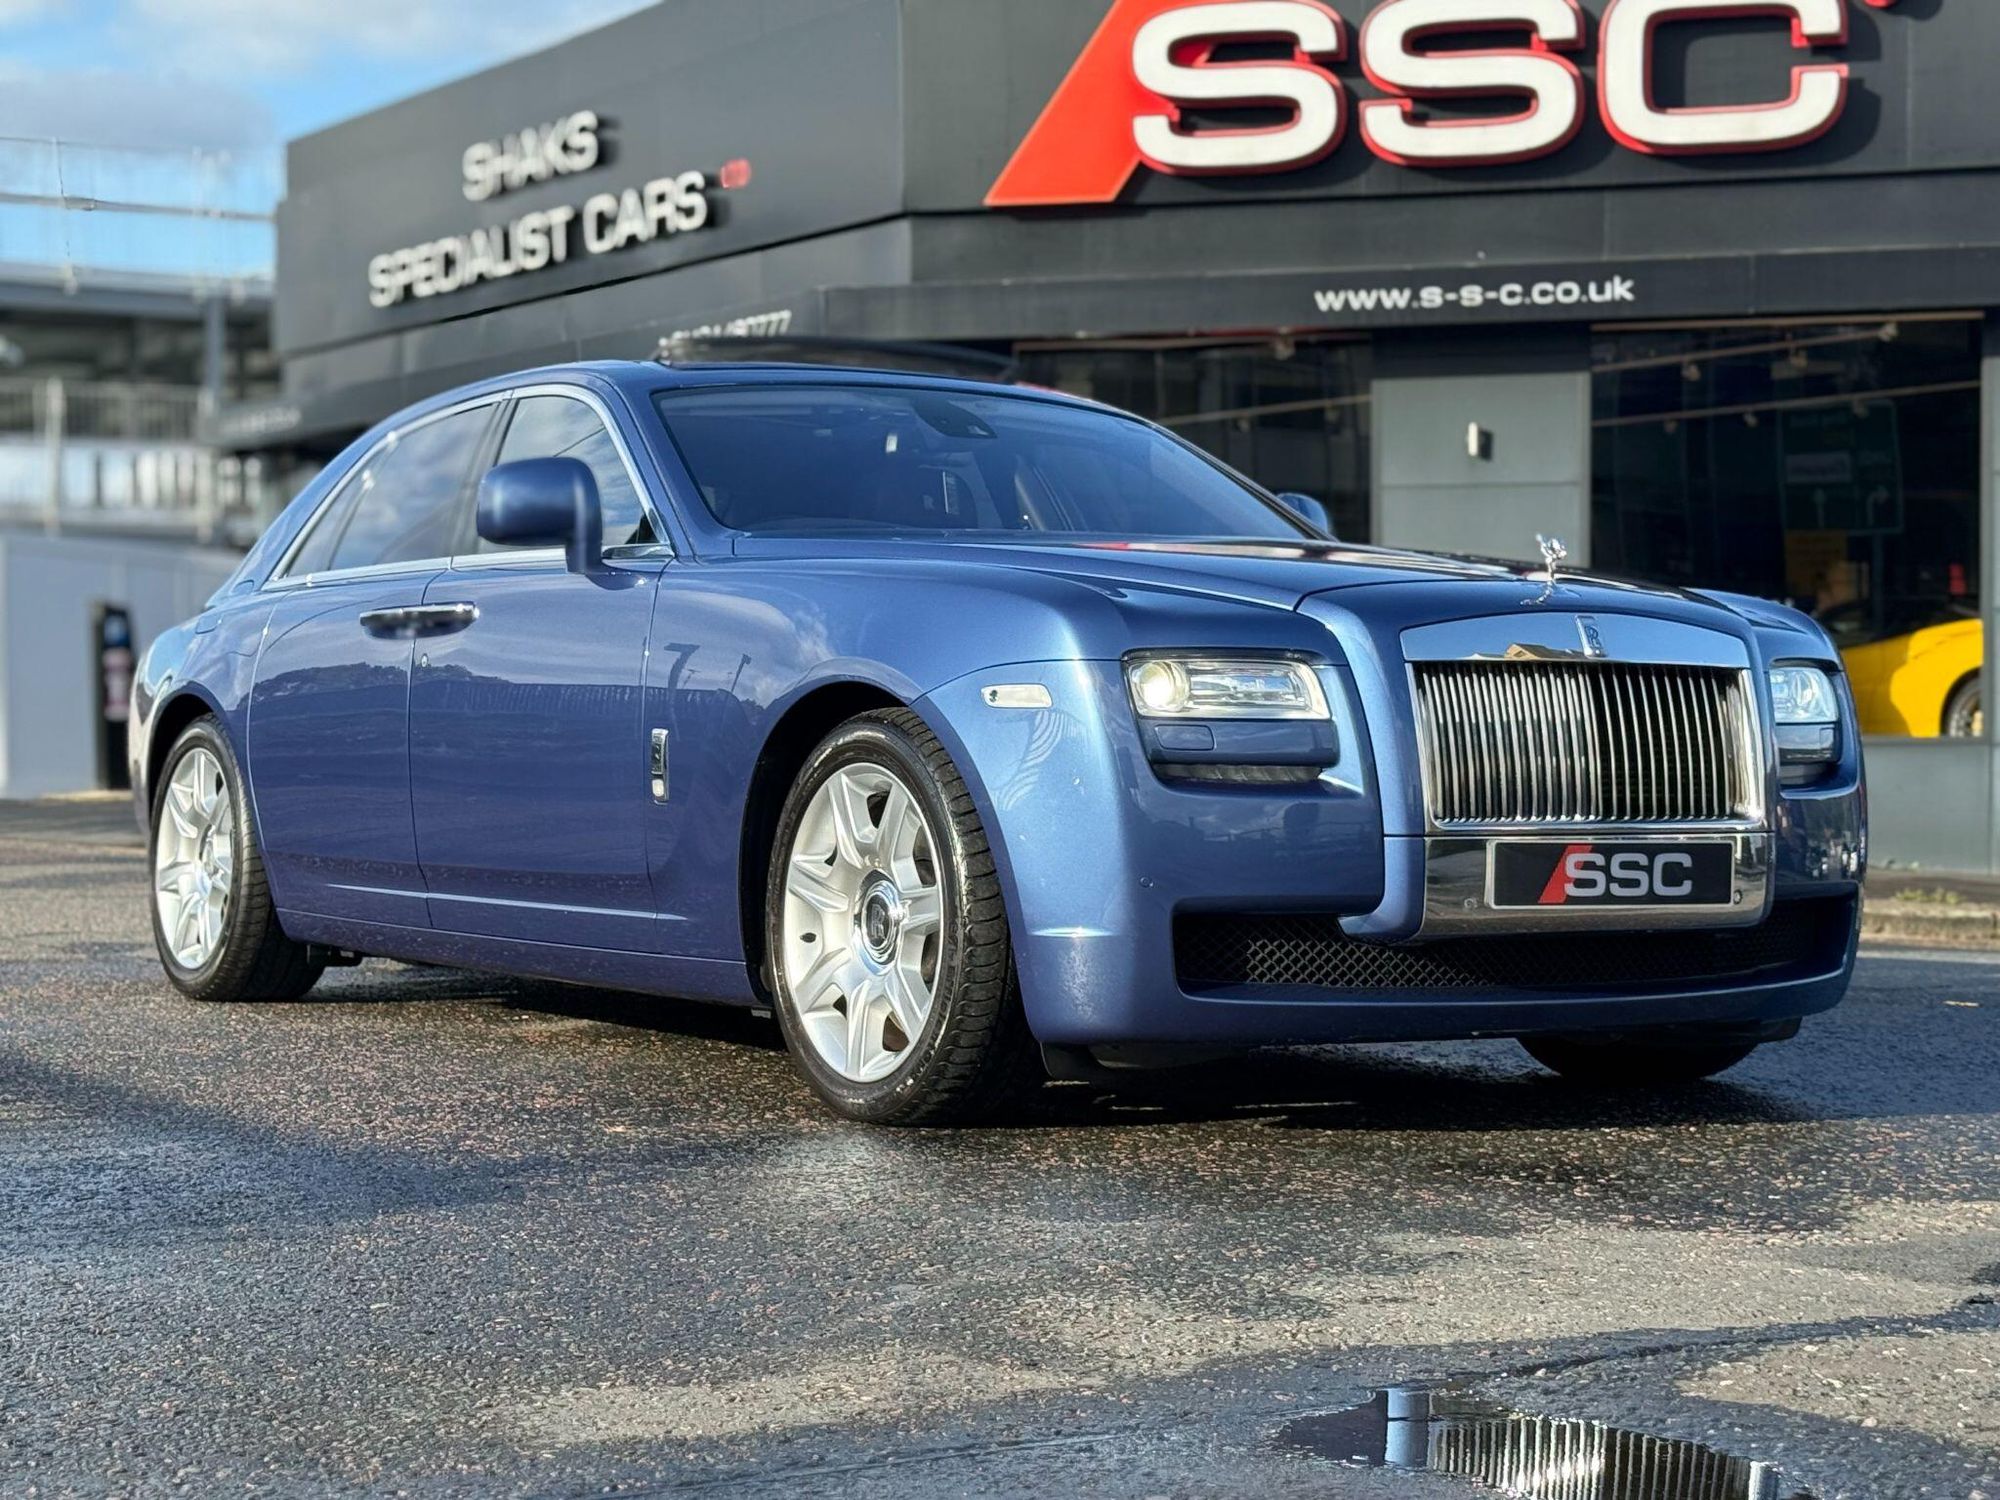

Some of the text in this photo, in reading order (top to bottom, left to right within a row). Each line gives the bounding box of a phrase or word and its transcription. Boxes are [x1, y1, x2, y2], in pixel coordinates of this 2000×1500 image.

[1131, 0, 1849, 174] SSC
[462, 110, 599, 202] SHAKS
[368, 170, 708, 308] SPECIALIST CARS
[1314, 275, 1635, 312] www.s-s-c.co.uk
[1563, 852, 1693, 897] SSC
